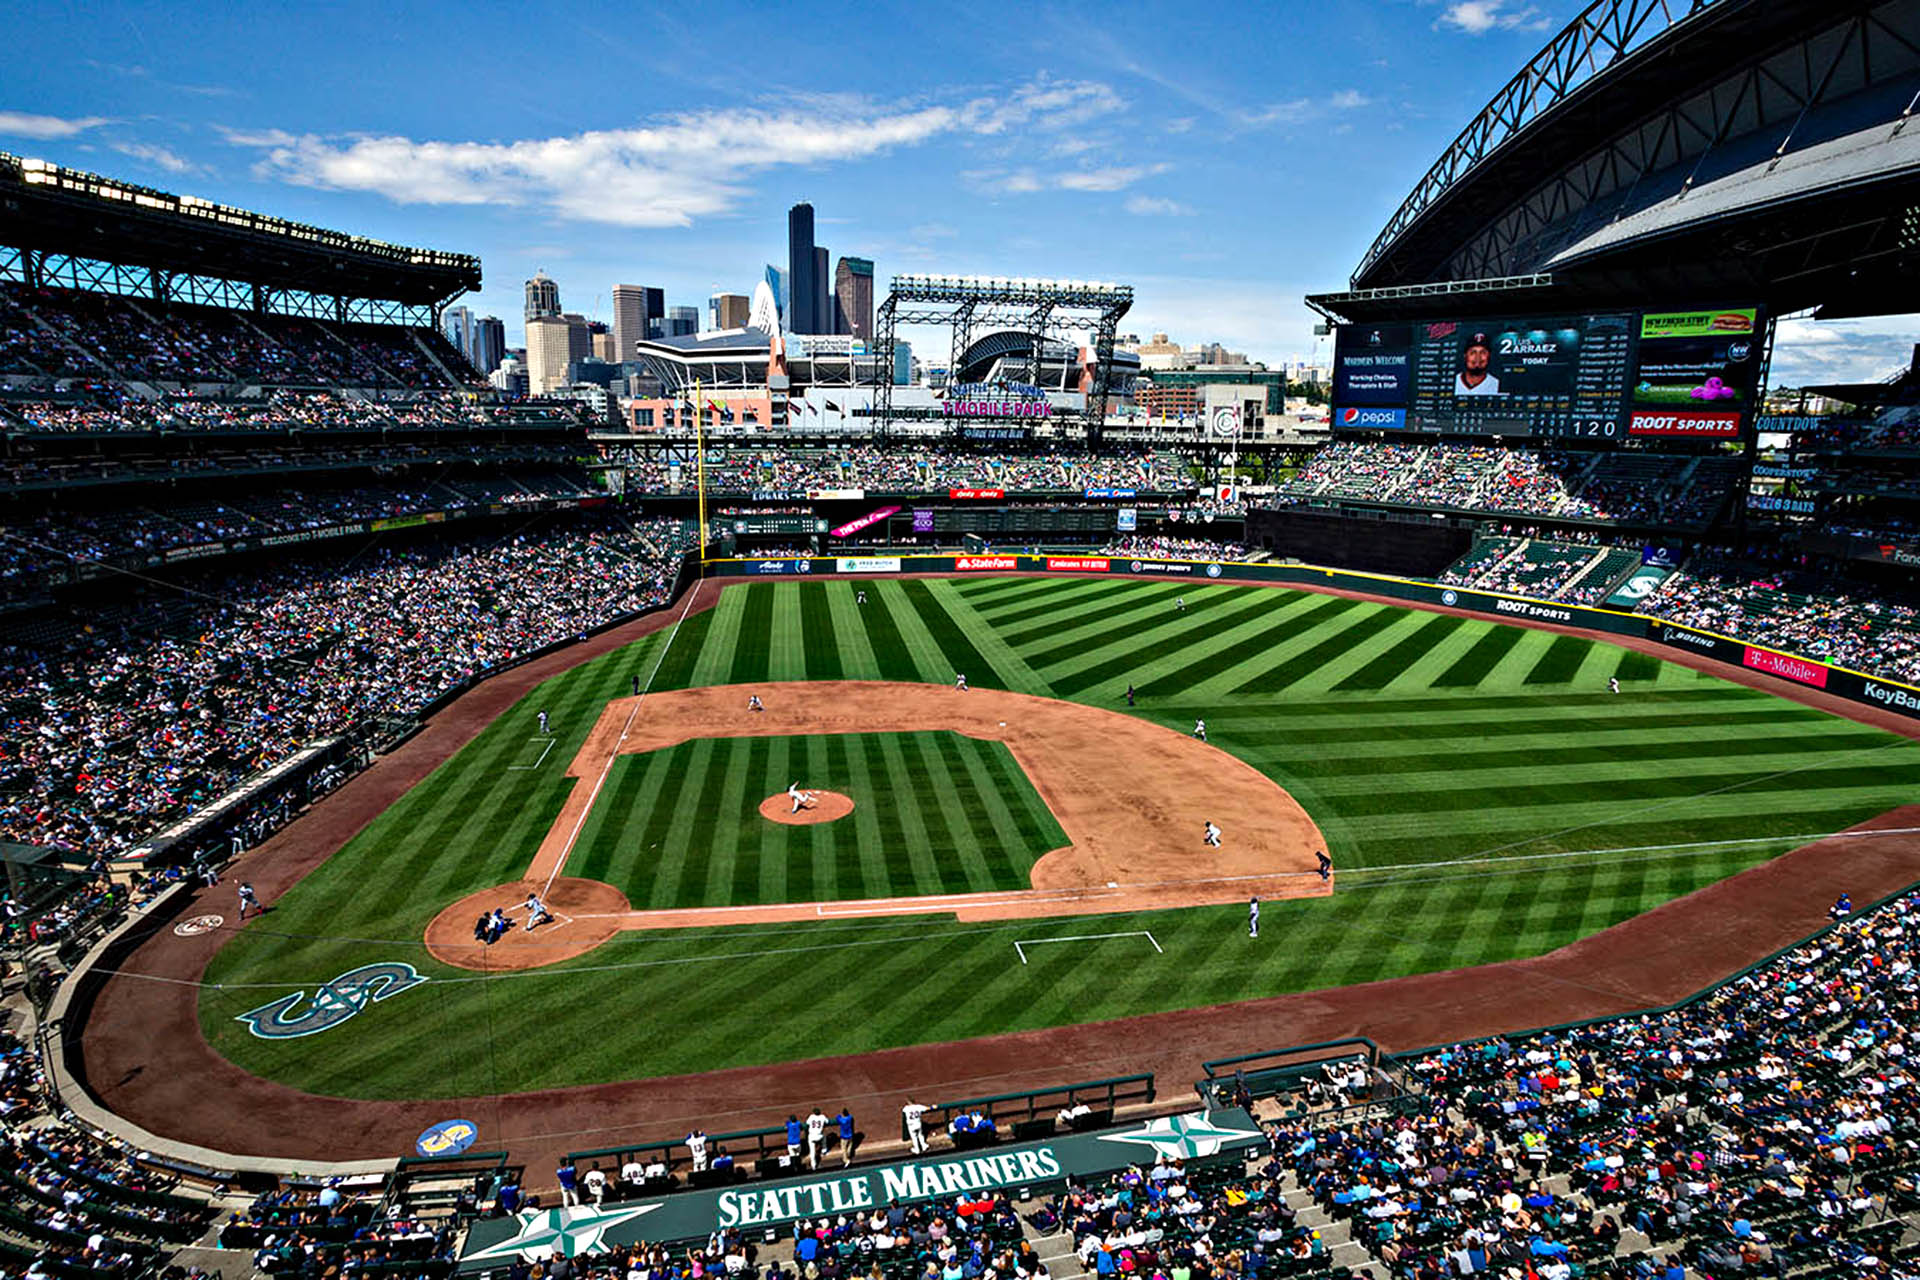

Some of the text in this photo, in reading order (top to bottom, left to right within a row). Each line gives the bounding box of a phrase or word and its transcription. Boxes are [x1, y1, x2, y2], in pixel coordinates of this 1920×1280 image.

[1500, 339, 1512, 354] 2
[1512, 344, 1557, 354] ARRAEZ
[1522, 356, 1549, 365] TODAY
[1014, 402, 1053, 417] PARK
[1361, 410, 1396, 424] pepsi
[1573, 421, 1580, 435] 1
[1588, 421, 1599, 436] 2
[1605, 421, 1615, 436] 0
[1632, 416, 1678, 429] ROOT
[1496, 600, 1571, 621] ROOT SPORTS
[1675, 631, 1716, 648] BOEING
[718, 1147, 1061, 1227] SEATTLE MARINERS
